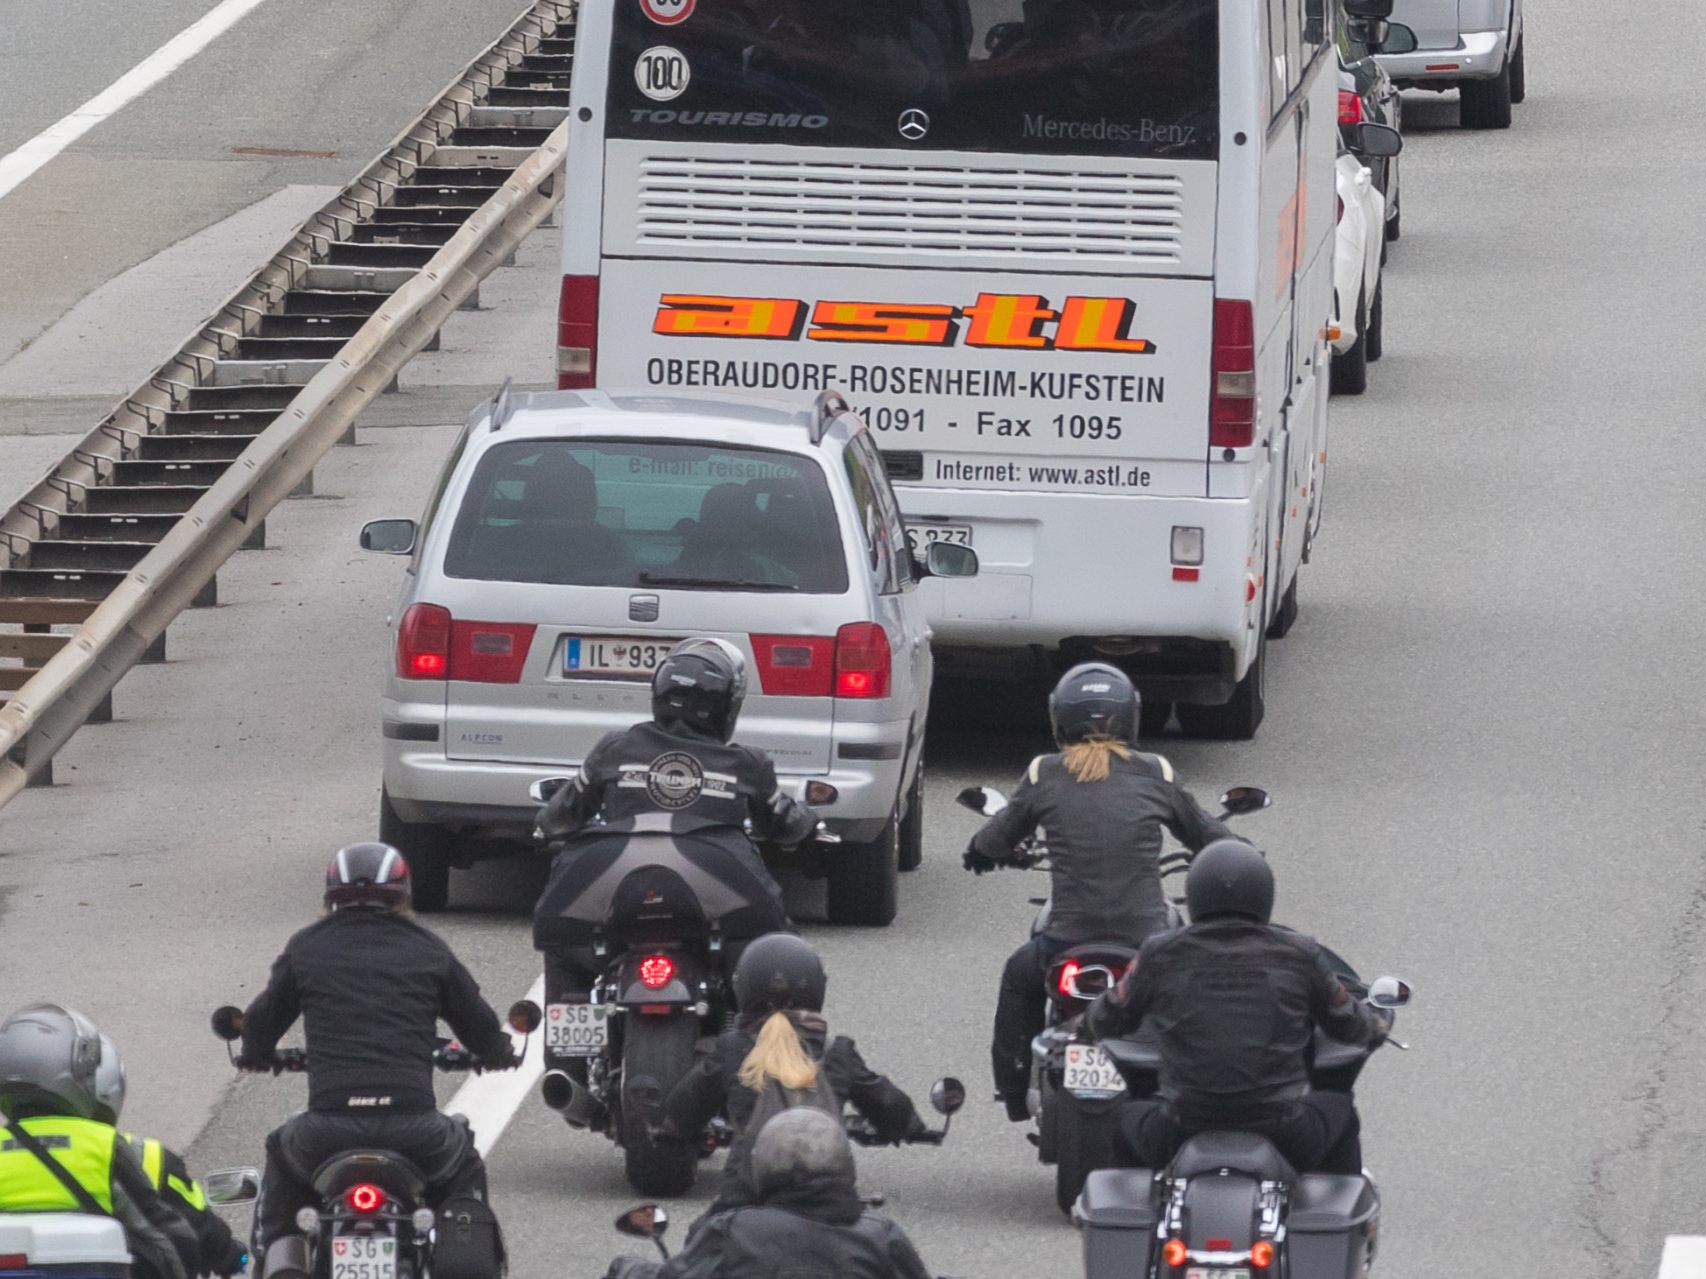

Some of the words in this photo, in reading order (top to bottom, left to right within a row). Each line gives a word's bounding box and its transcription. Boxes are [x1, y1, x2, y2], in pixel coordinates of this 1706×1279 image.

[642, 55, 683, 91] 100
[629, 109, 830, 129] TOURISMO
[1023, 114, 1195, 143] Mercedes-Benz
[652, 291, 1157, 355] astl
[647, 357, 1165, 404] OBERAUDORF-ROSENHEIM-KUFSTEIN
[977, 411, 1032, 438] Fax
[1052, 414, 1122, 440] 1095
[936, 460, 1022, 482] Internet:
[1028, 465, 1151, 487] www.astl.de
[590, 644, 610, 668] IL
[565, 1006, 588, 1024] SG
[550, 1026, 604, 1045] 38005
[351, 1238, 377, 1259] SG
[335, 1263, 393, 1279] 25515
